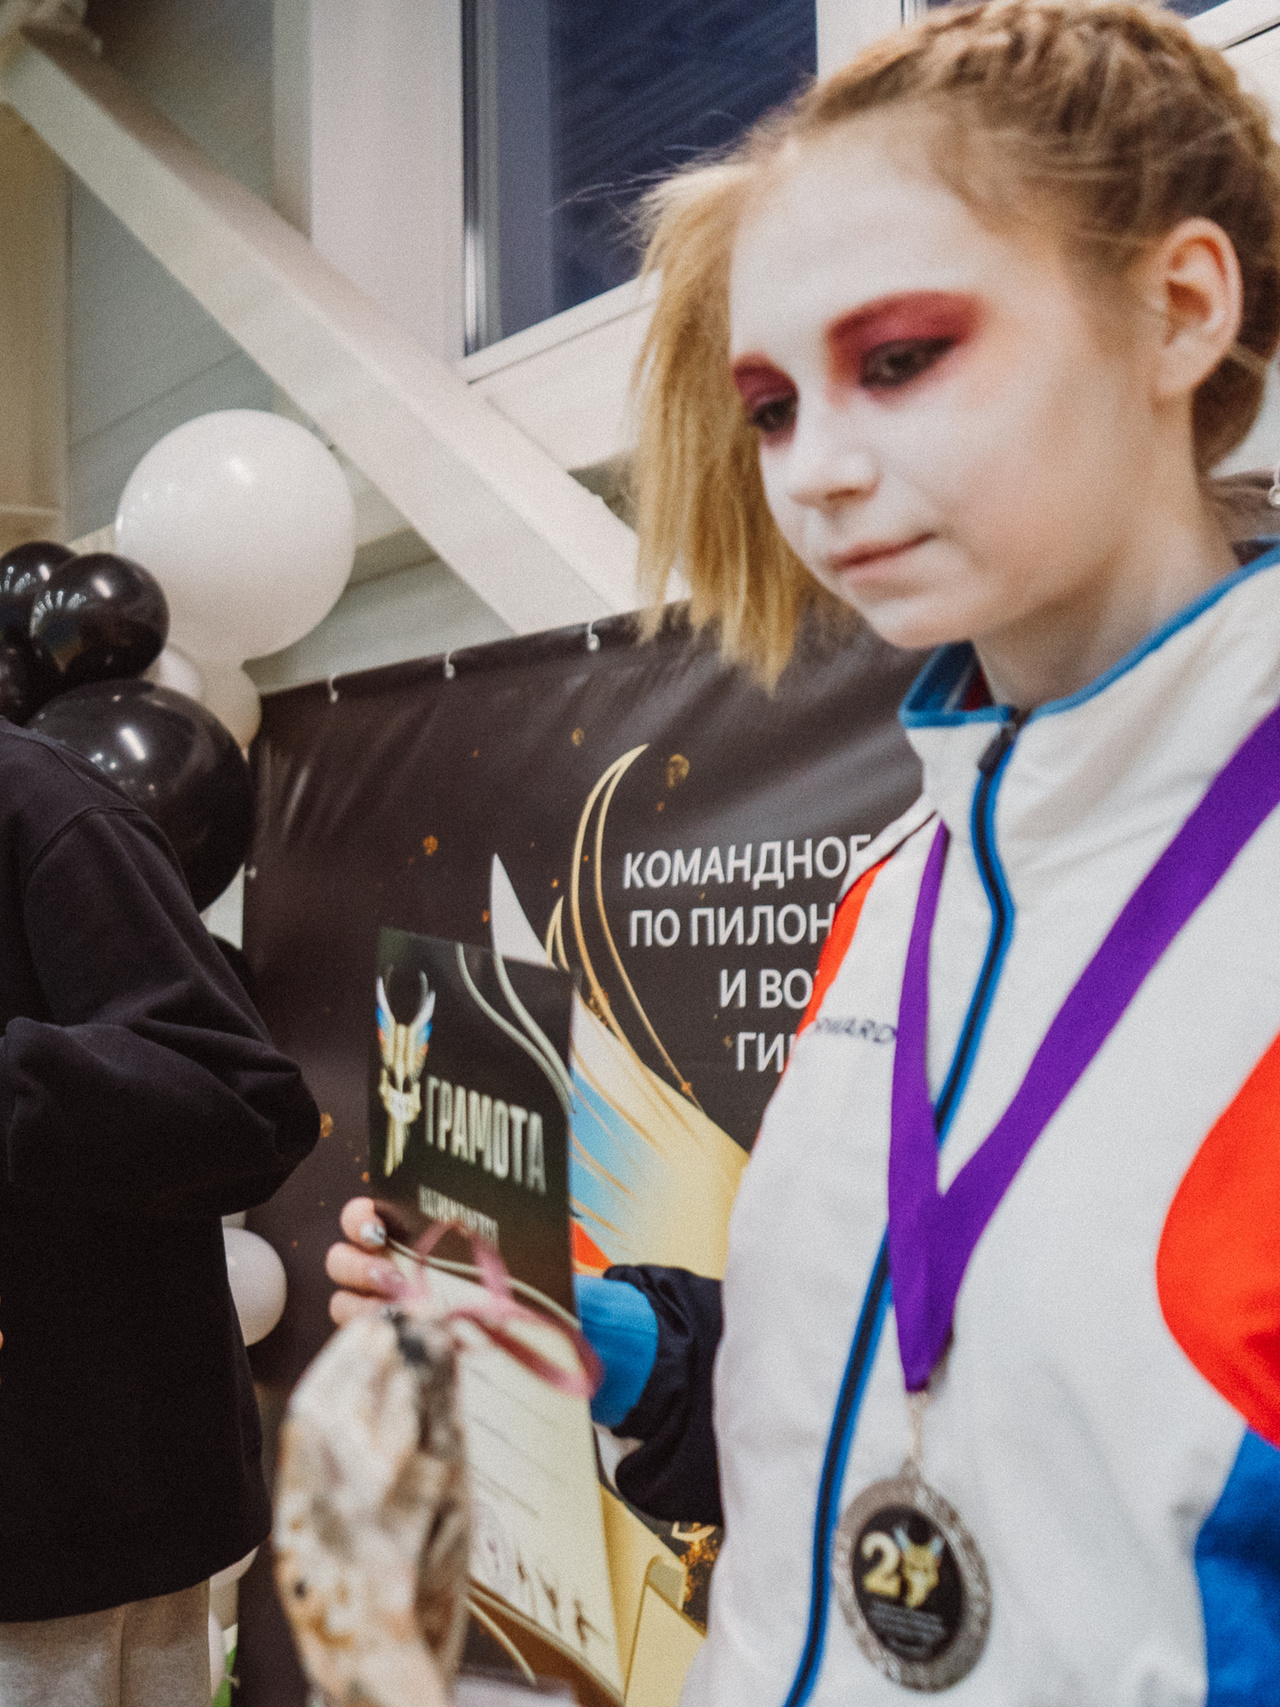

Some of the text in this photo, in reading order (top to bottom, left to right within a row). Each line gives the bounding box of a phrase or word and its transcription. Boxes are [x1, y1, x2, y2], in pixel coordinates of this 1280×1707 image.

[629, 908, 681, 947] ПО
[719, 967, 818, 1010] И ВО
[737, 1032, 796, 1073] ГИ
[425, 1074, 548, 1197] ГРАМОТА
[861, 1531, 901, 1598] 2
